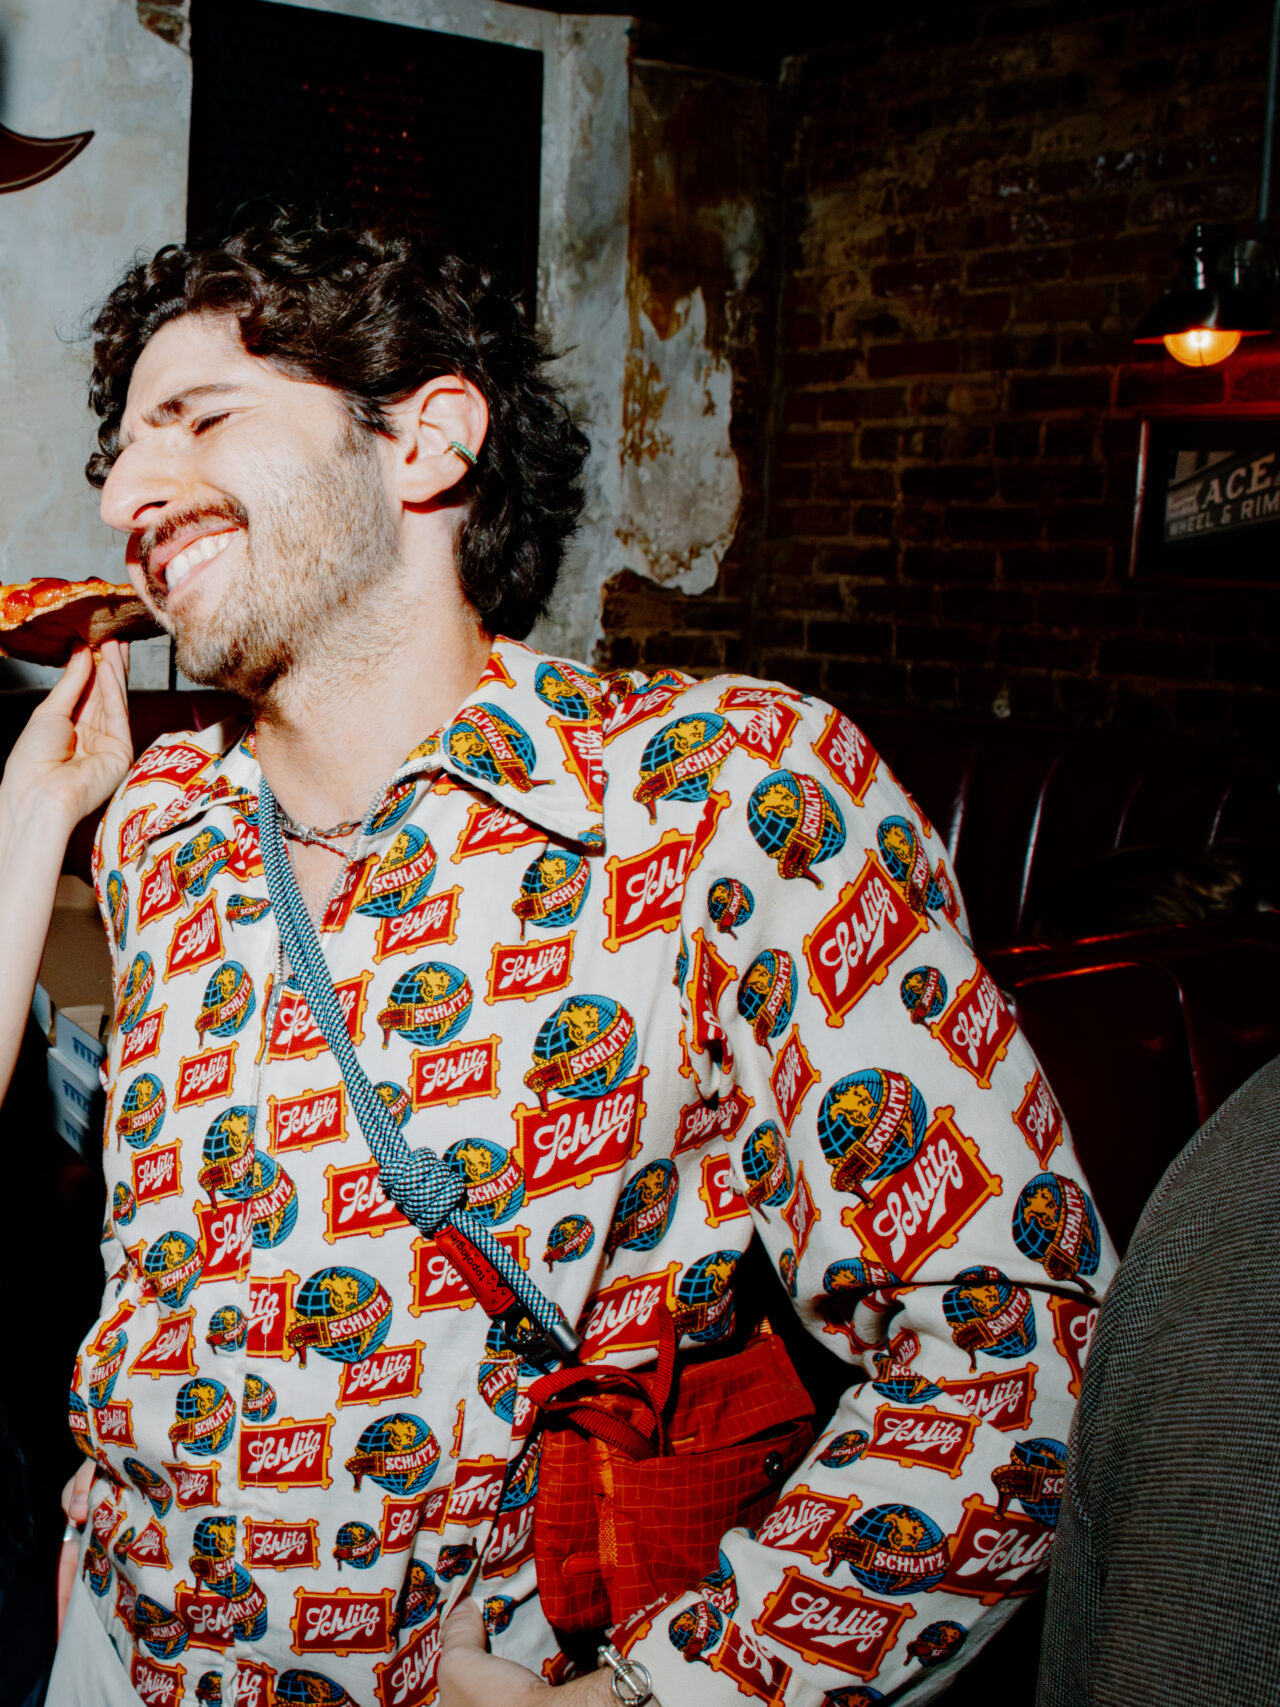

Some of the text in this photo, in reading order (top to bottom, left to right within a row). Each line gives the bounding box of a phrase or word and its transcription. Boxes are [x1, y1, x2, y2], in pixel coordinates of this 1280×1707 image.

[1201, 453, 1276, 510] ACE
[556, 661, 601, 699] SCHLITZ
[461, 707, 513, 760] SCHLITZ
[674, 730, 737, 777] SCHLITZ
[829, 714, 867, 786] Schlitz
[130, 745, 203, 781] Schlitz
[801, 777, 818, 838] SCHLITZ
[189, 846, 228, 879] SCHLITZ
[371, 851, 434, 893] SCHLITZ
[240, 900, 270, 915] SCHLITZ
[544, 866, 589, 911] SCHLITZ
[624, 848, 691, 925] Schl
[385, 898, 449, 949] Schlitz
[820, 876, 898, 997] Schlitz
[498, 944, 567, 989] Schlitz
[767, 953, 790, 1017] SCHLITZ
[921, 968, 939, 1006] SCHLITZ
[220, 980, 251, 1020] SCHLITZ
[414, 988, 469, 1024] SCHLITZ
[951, 974, 1007, 1068] Schlitz
[124, 1016, 159, 1061] Schlitz
[571, 1017, 633, 1075] SCHLITZ
[181, 1055, 228, 1098] Schlitz
[420, 1048, 488, 1097] Schlitz
[775, 1043, 803, 1119] Schlitz
[132, 1096, 164, 1129] SCHLITZ
[278, 1098, 339, 1142] Schlitz
[866, 1077, 907, 1155] SCHLITZ
[533, 1091, 636, 1180] Schlitz
[137, 1152, 175, 1195] Schlitz
[467, 1168, 519, 1204] SCHLITZ
[253, 1179, 292, 1219] CHLITZ
[872, 1137, 964, 1264] Schlitz
[1060, 1180, 1082, 1256] SCHLITZ
[449, 1232, 486, 1283] topologie
[563, 1224, 593, 1253] SCHLITZ
[162, 1255, 202, 1290] SCHLITZ
[328, 1293, 388, 1339] SCHLITZ
[986, 1293, 1028, 1336] SCHLITZ
[346, 1352, 412, 1395] Schlitz
[194, 1401, 235, 1435] SCHLITZ
[875, 1416, 964, 1452] Schlitz
[247, 1428, 322, 1475] Schlitz
[386, 1444, 437, 1472] SCHLITZ
[252, 1525, 308, 1561] Schlitz
[761, 1499, 836, 1548] Schlitz
[874, 1550, 944, 1574] SCHLITZ
[956, 1527, 1056, 1583] Schli
[150, 1618, 186, 1639] SCHLITZ
[304, 1603, 381, 1642] Schlitz
[773, 1591, 889, 1653] Schlitz
[391, 1627, 442, 1705] Schlit
